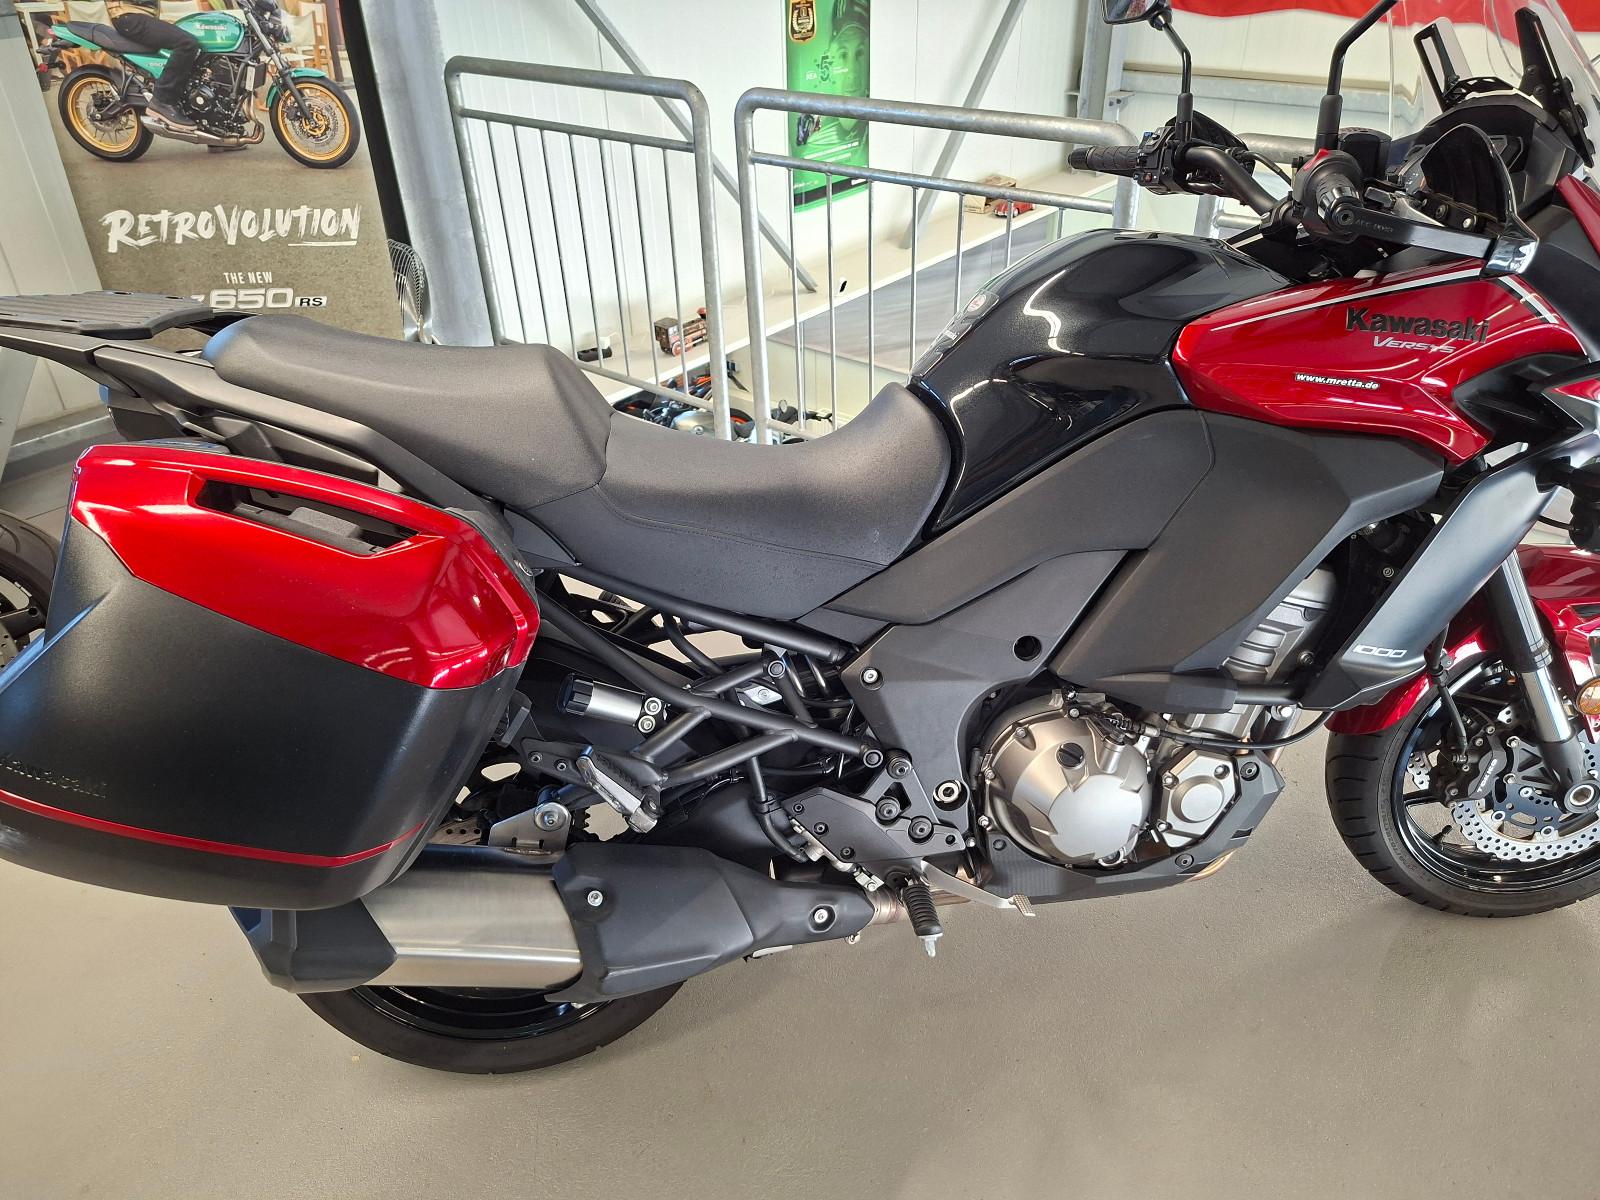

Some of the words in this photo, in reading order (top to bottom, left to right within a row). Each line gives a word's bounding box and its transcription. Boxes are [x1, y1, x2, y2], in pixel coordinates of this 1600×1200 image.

[224, 272, 246, 284] THE
[248, 271, 273, 284] NEW
[297, 296, 325, 307] RS
[1346, 306, 1489, 344] Kawasaki
[1373, 335, 1456, 354] VERSYS
[1296, 373, 1380, 390] www.mretta.de
[1352, 644, 1408, 658] 1000
